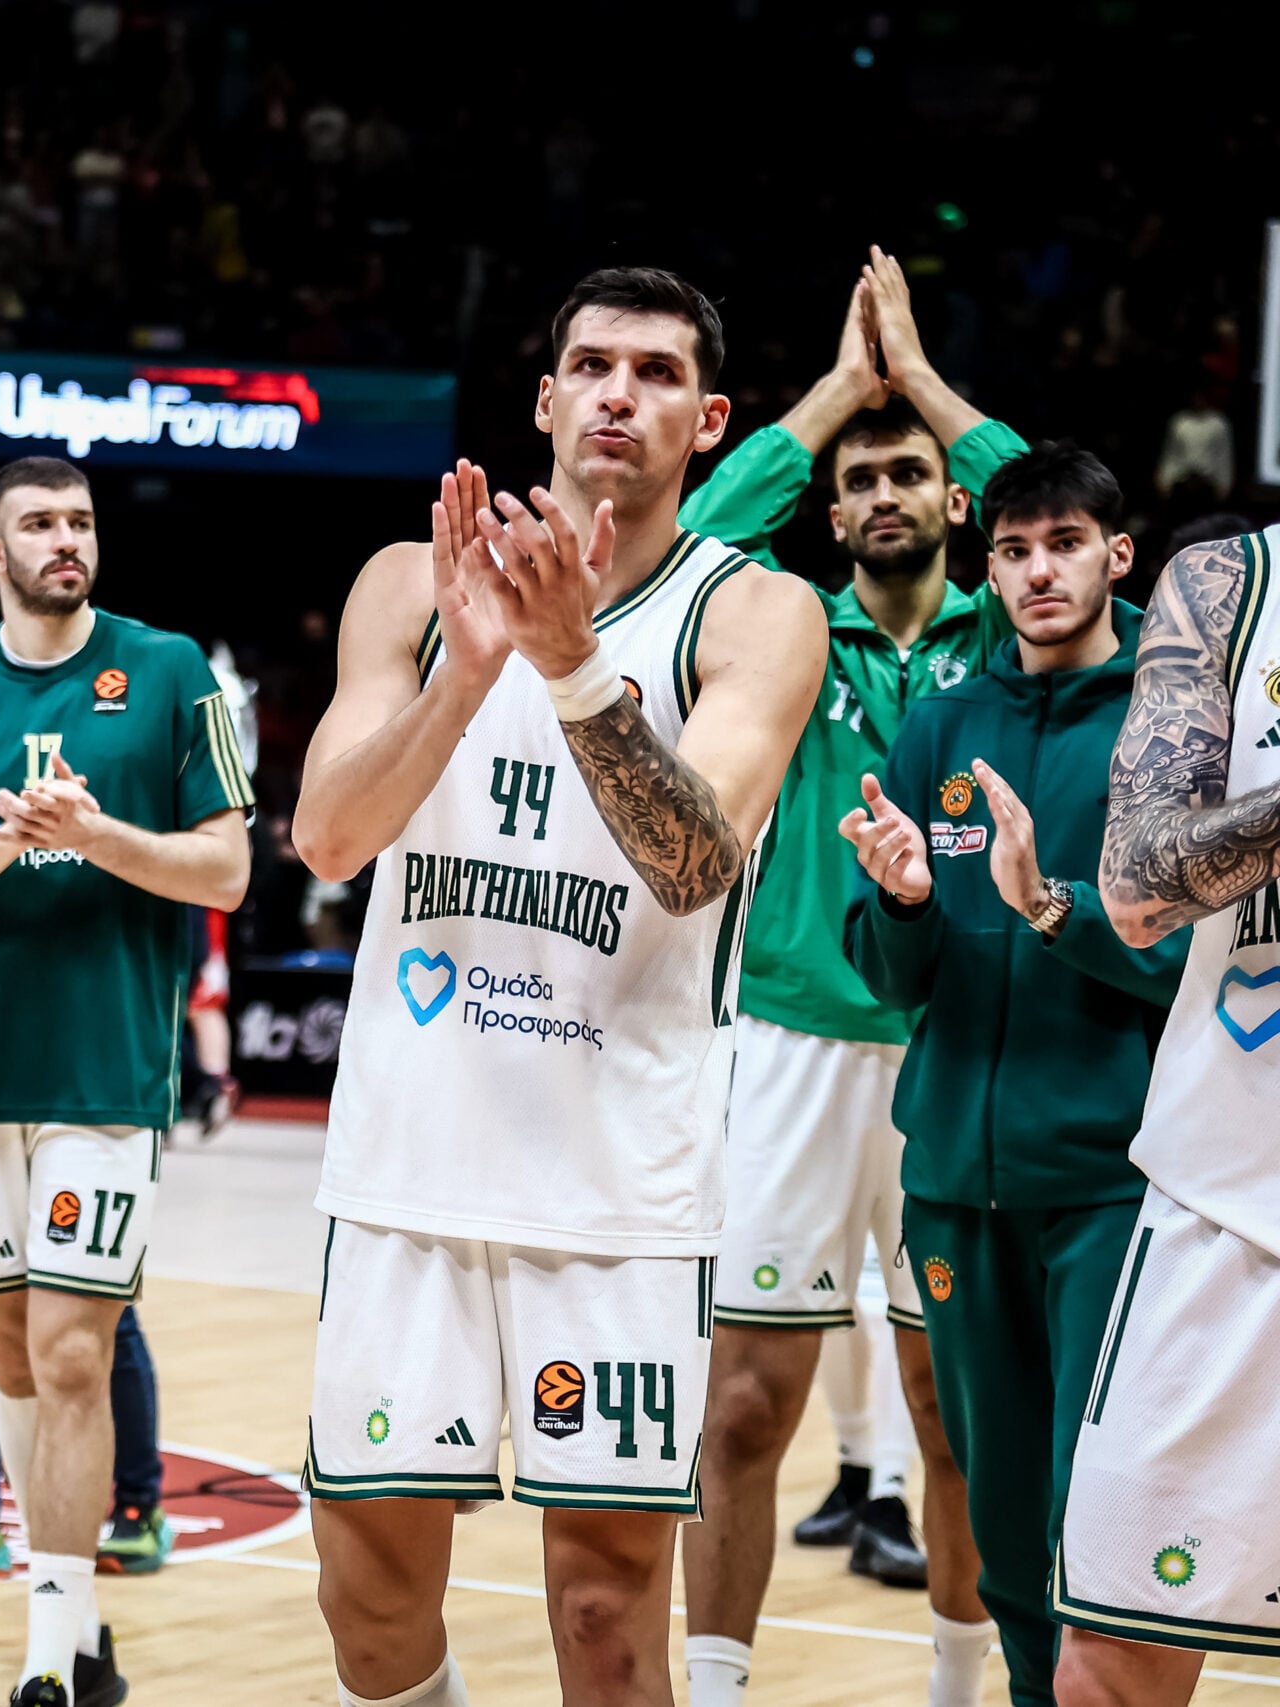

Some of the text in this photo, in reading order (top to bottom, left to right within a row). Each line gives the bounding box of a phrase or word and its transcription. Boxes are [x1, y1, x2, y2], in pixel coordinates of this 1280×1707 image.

[23, 732, 63, 790] 17
[489, 756, 555, 841] 44
[401, 852, 630, 957] PANATHINAIKOS
[467, 966, 553, 1001] Ομάδα
[463, 1001, 604, 1051] Προσφοράς
[86, 1189, 136, 1259] 17
[380, 1395, 393, 1409] bp
[593, 1361, 677, 1461] 44
[1183, 1532, 1202, 1550] bp
